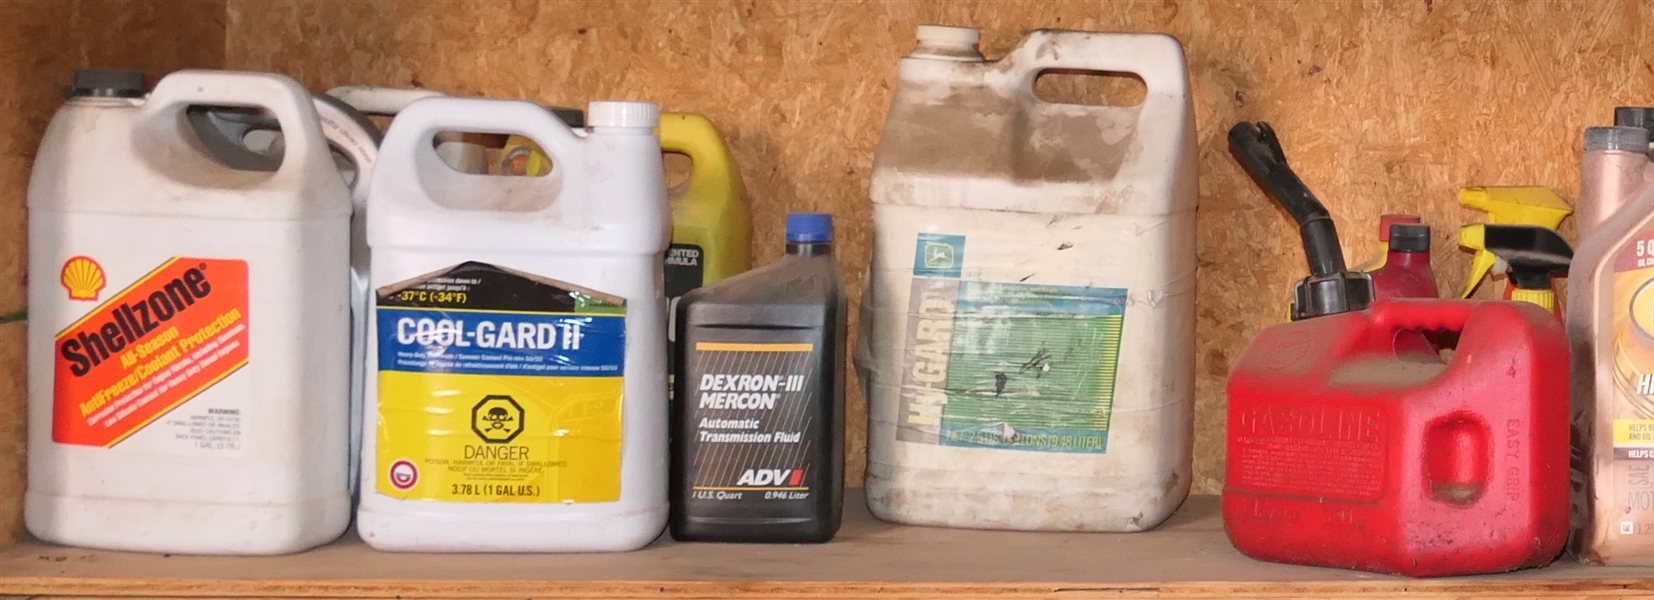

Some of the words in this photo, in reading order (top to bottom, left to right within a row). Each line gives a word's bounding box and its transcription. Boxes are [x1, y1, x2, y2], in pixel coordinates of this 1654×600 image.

[1636, 240, 1645, 257] 5
[1637, 258, 1646, 268] OIL
[397, 291, 427, 302] -37°C
[429, 292, 467, 304] (-34°F)
[60, 267, 211, 378] Shellzone
[396, 317, 556, 350] COOL-GARD
[120, 326, 180, 370] All-Season
[79, 346, 182, 418] AntiFreeze/Coolant
[178, 308, 241, 353] Protection
[699, 392, 776, 409] MERCON
[699, 417, 759, 429] Automatic
[1241, 406, 1381, 442] GASOLINE
[1628, 424, 1648, 432] HELPS
[699, 431, 772, 443] Transmission
[773, 431, 801, 443] Fluid
[1506, 418, 1521, 460] EASY
[464, 444, 529, 460] DANGER
[1628, 450, 1649, 458] HELPS
[736, 469, 791, 486] ADV
[1506, 466, 1520, 501] GRIP
[1628, 464, 1649, 486] SAE
[452, 484, 472, 495] 3.78
[475, 485, 480, 495] L
[495, 485, 515, 496] GAL
[518, 486, 540, 497] U.S.)
[697, 490, 715, 499] U.S.
[716, 490, 743, 500] Quart
[764, 491, 788, 500] 0.946
[788, 491, 810, 500] Liter
